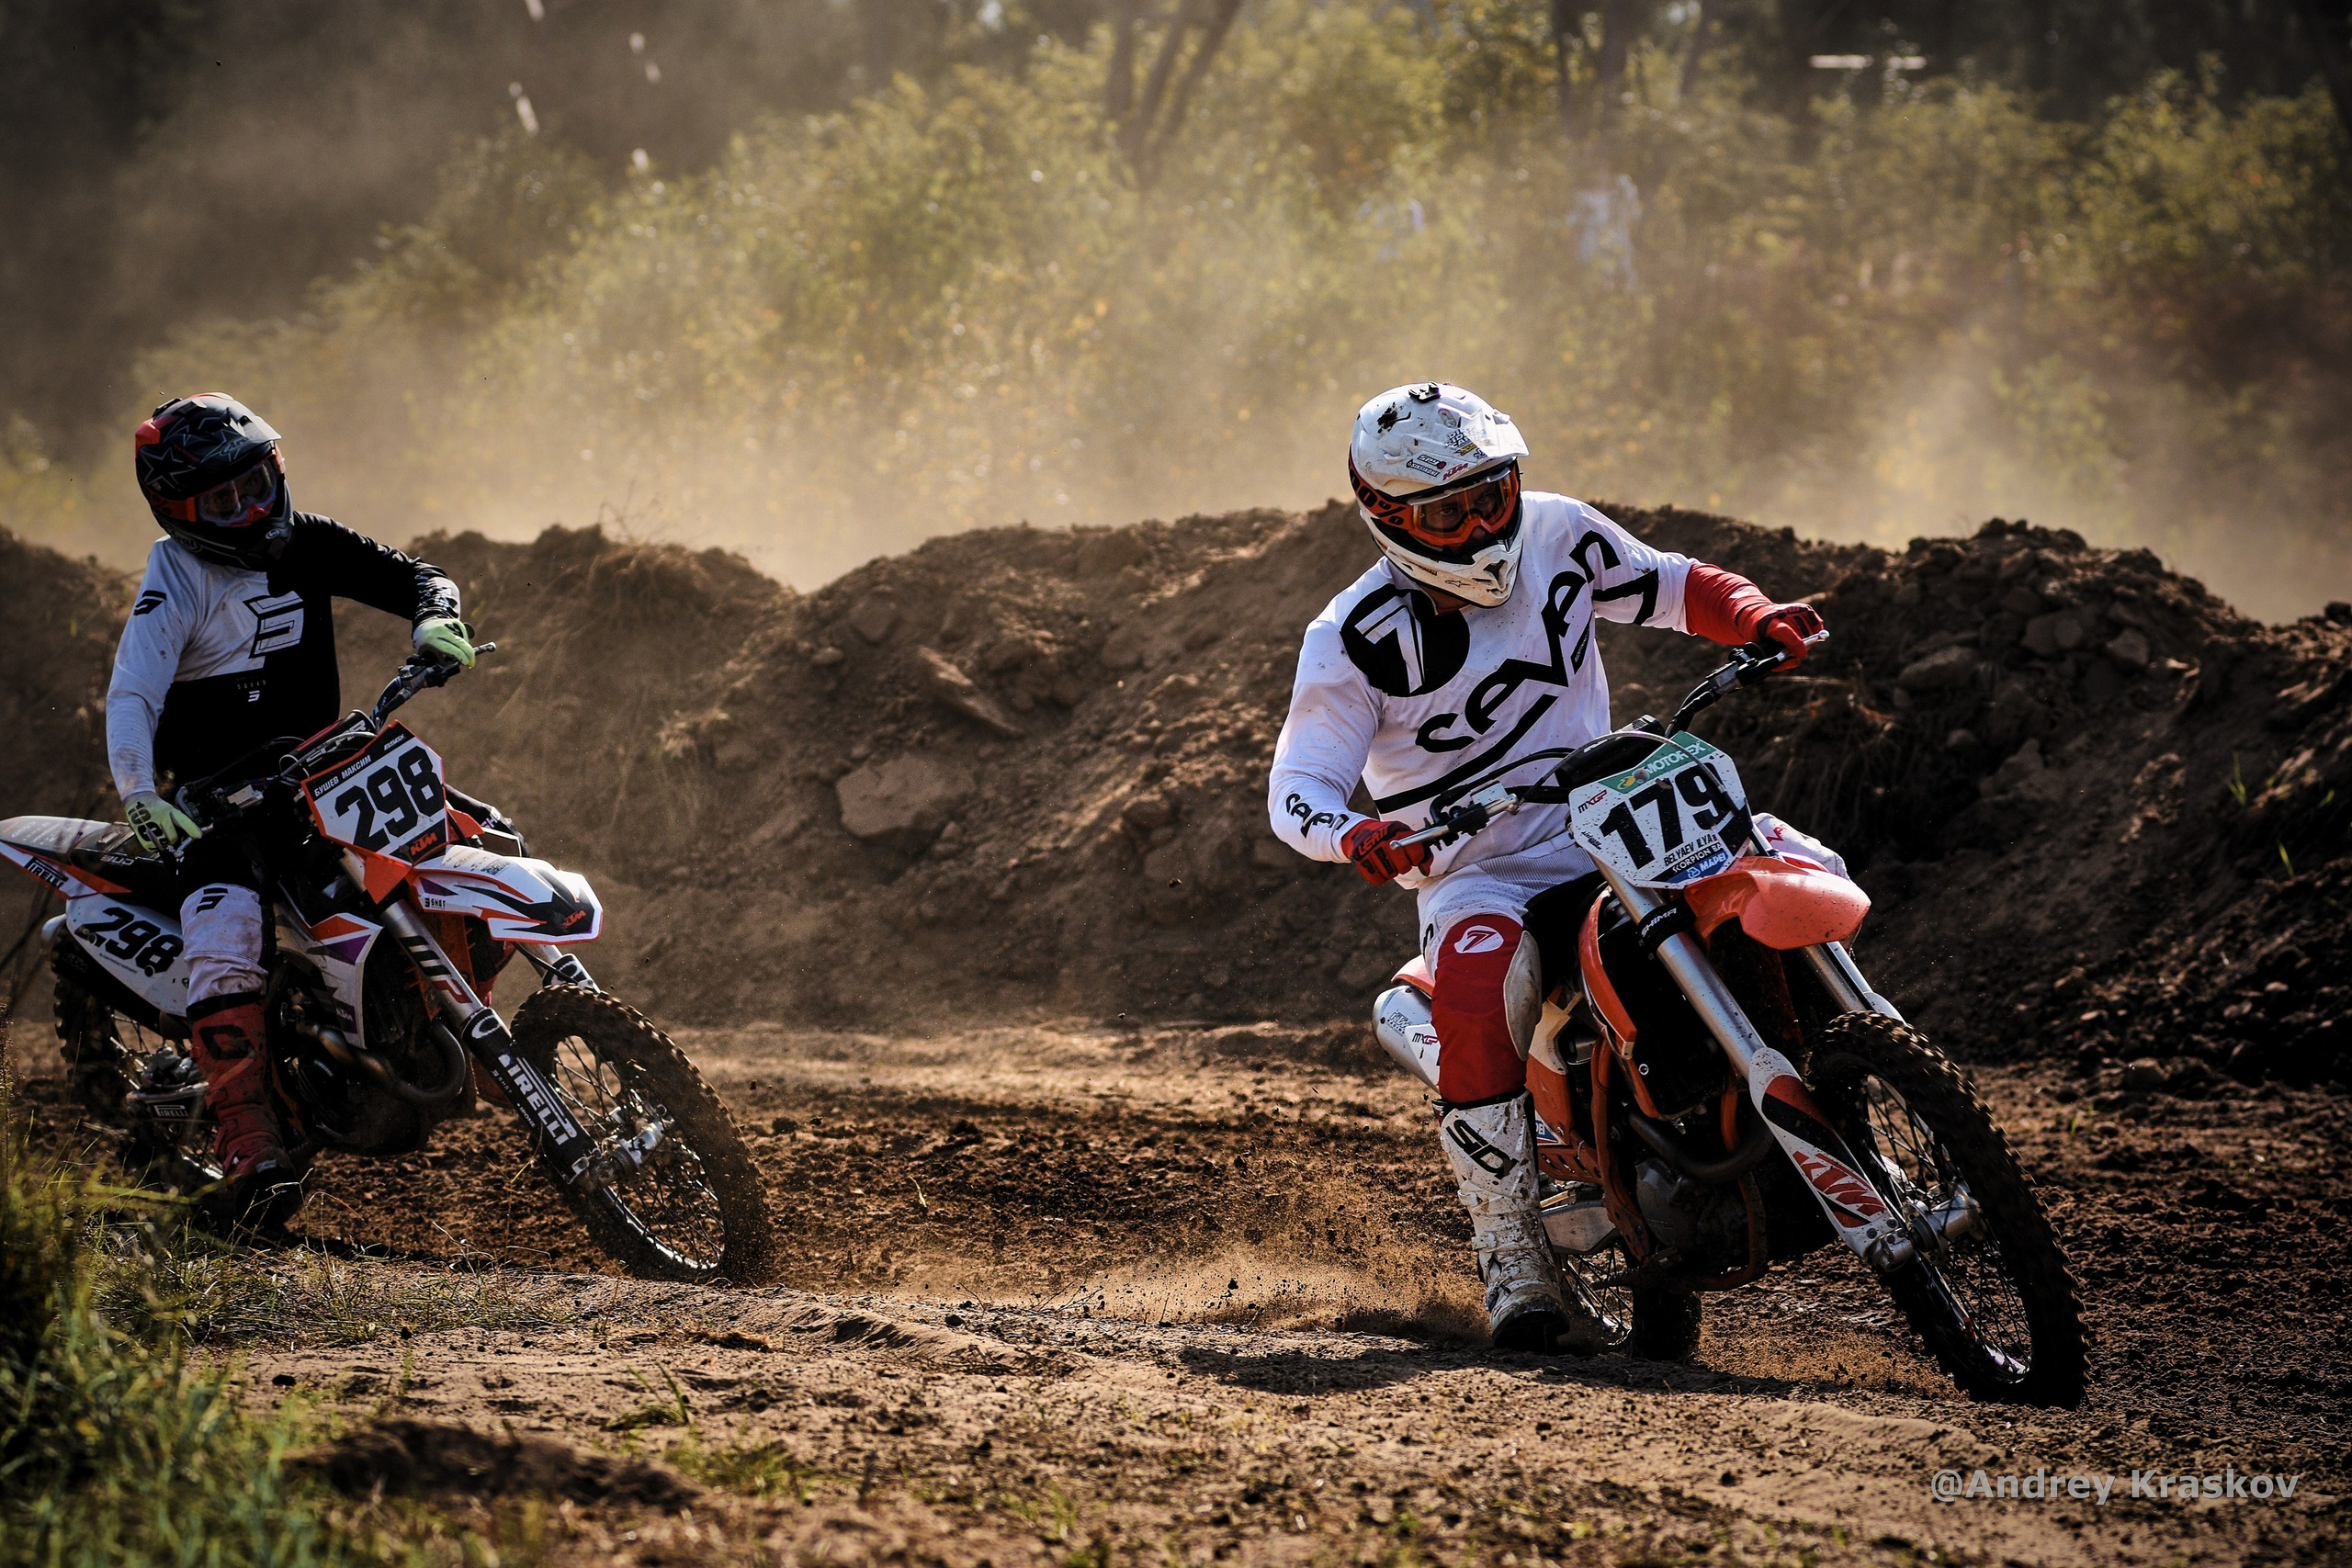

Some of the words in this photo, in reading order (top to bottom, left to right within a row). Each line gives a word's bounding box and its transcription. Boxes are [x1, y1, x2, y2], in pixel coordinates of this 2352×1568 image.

[1442, 462, 1469, 481] KTM
[314, 776, 339, 797] БУШЕВ
[341, 754, 372, 780] МАКСИМ
[334, 745, 446, 853] 298
[1577, 790, 1607, 813] MXGP
[1600, 761, 1731, 871] 179
[410, 831, 438, 857] KTM
[1664, 841, 1695, 867] BELYAEV
[1696, 833, 1714, 850] ILYA
[28, 859, 68, 888] PIRELLI
[1672, 848, 1712, 874] SCORPION
[1700, 852, 1726, 872] MAPEI
[561, 909, 587, 929] KTM
[74, 907, 184, 974] 298
[153, 1104, 189, 1117] PIRELLI
[497, 1053, 578, 1146] PIRELLI
[519, 1106, 537, 1129] IPONE
[1792, 1150, 1887, 1217] KTM
